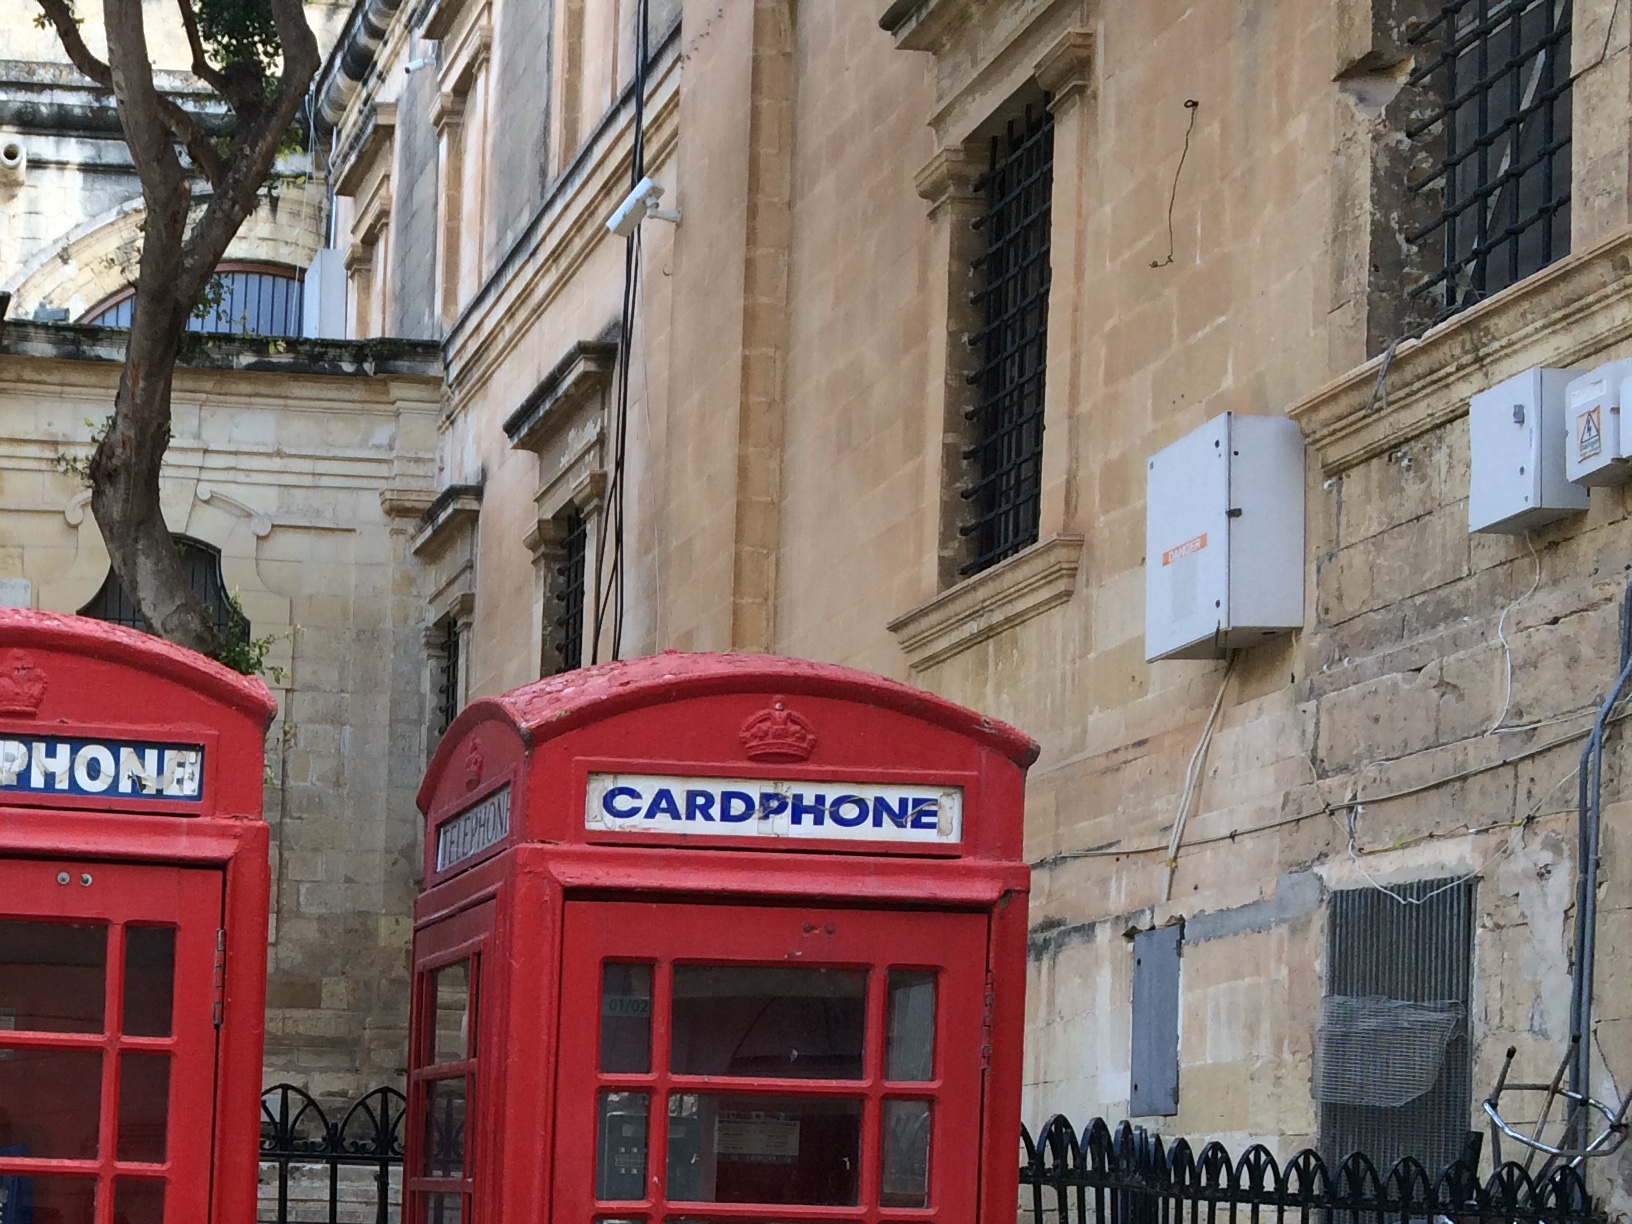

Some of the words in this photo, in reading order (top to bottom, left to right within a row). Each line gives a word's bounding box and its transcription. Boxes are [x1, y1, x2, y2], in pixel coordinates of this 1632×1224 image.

[1168, 538, 1201, 562] DANGER
[601, 785, 940, 830] CARDPHONE
[608, 999, 648, 1013] 01/02
